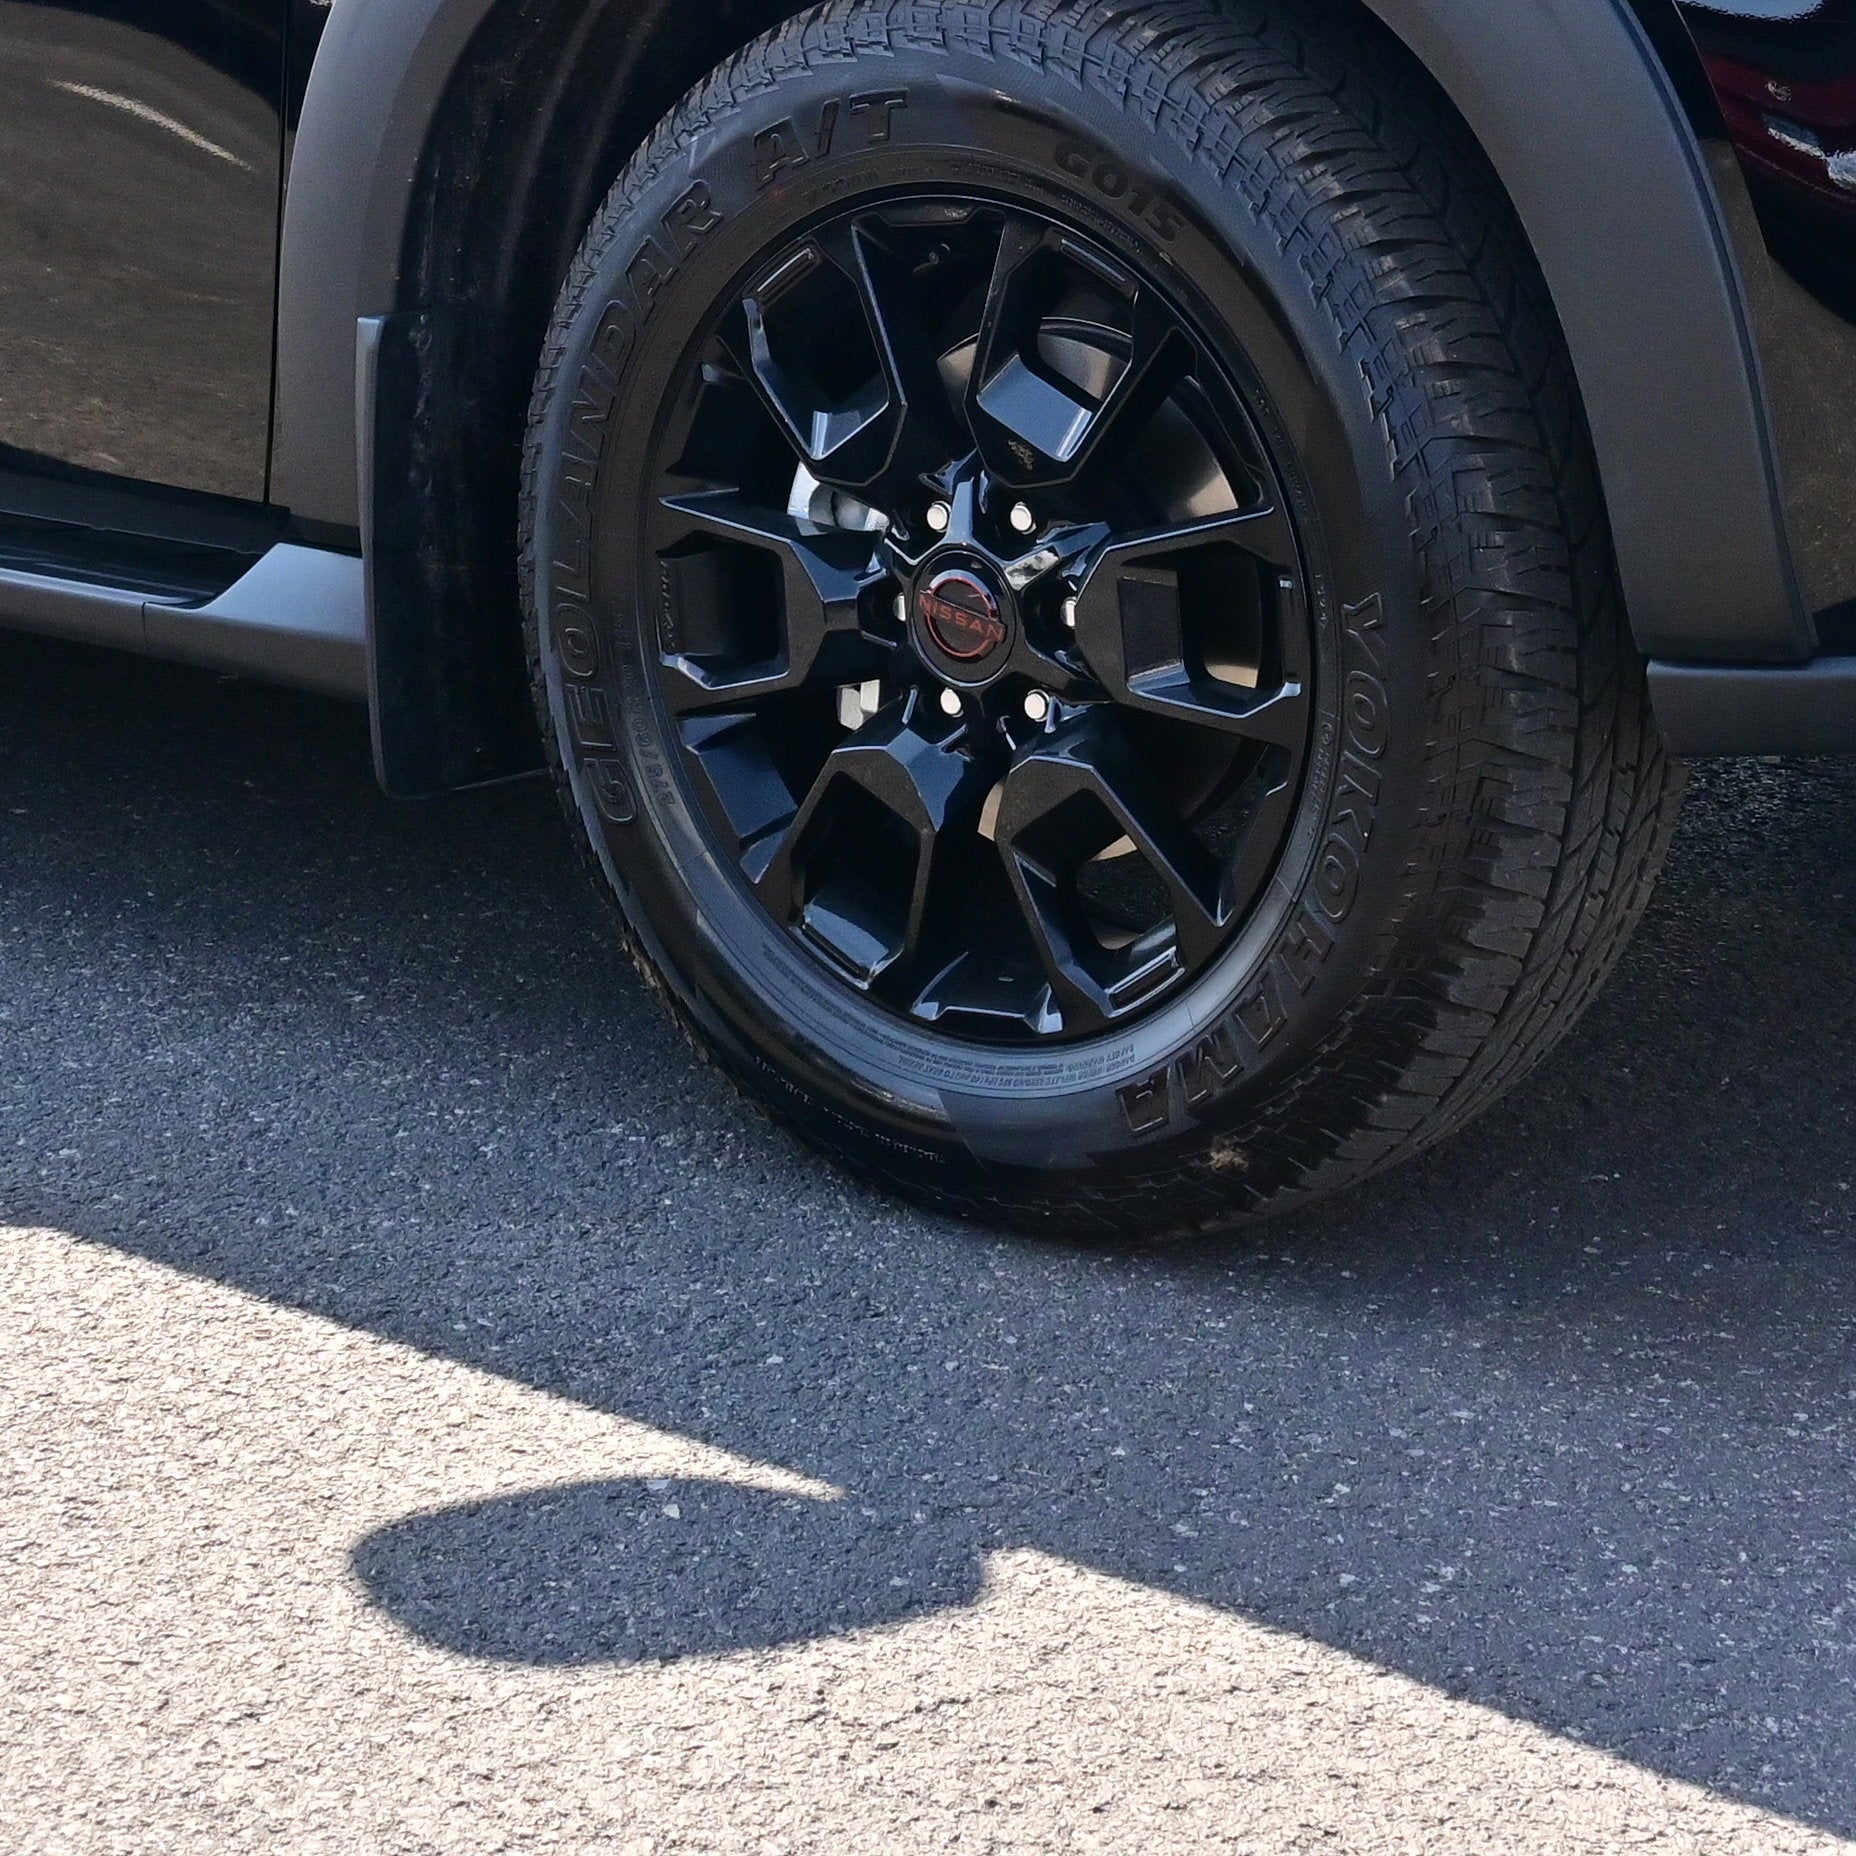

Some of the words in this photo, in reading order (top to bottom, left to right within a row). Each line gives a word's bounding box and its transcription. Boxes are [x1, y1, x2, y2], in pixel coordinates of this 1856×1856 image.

[553, 179, 724, 825] GEOLANDAR
[753, 87, 909, 189] A/T
[919, 593, 1004, 641] NISSAN
[1116, 592, 1391, 1133] YOKOHAMA
